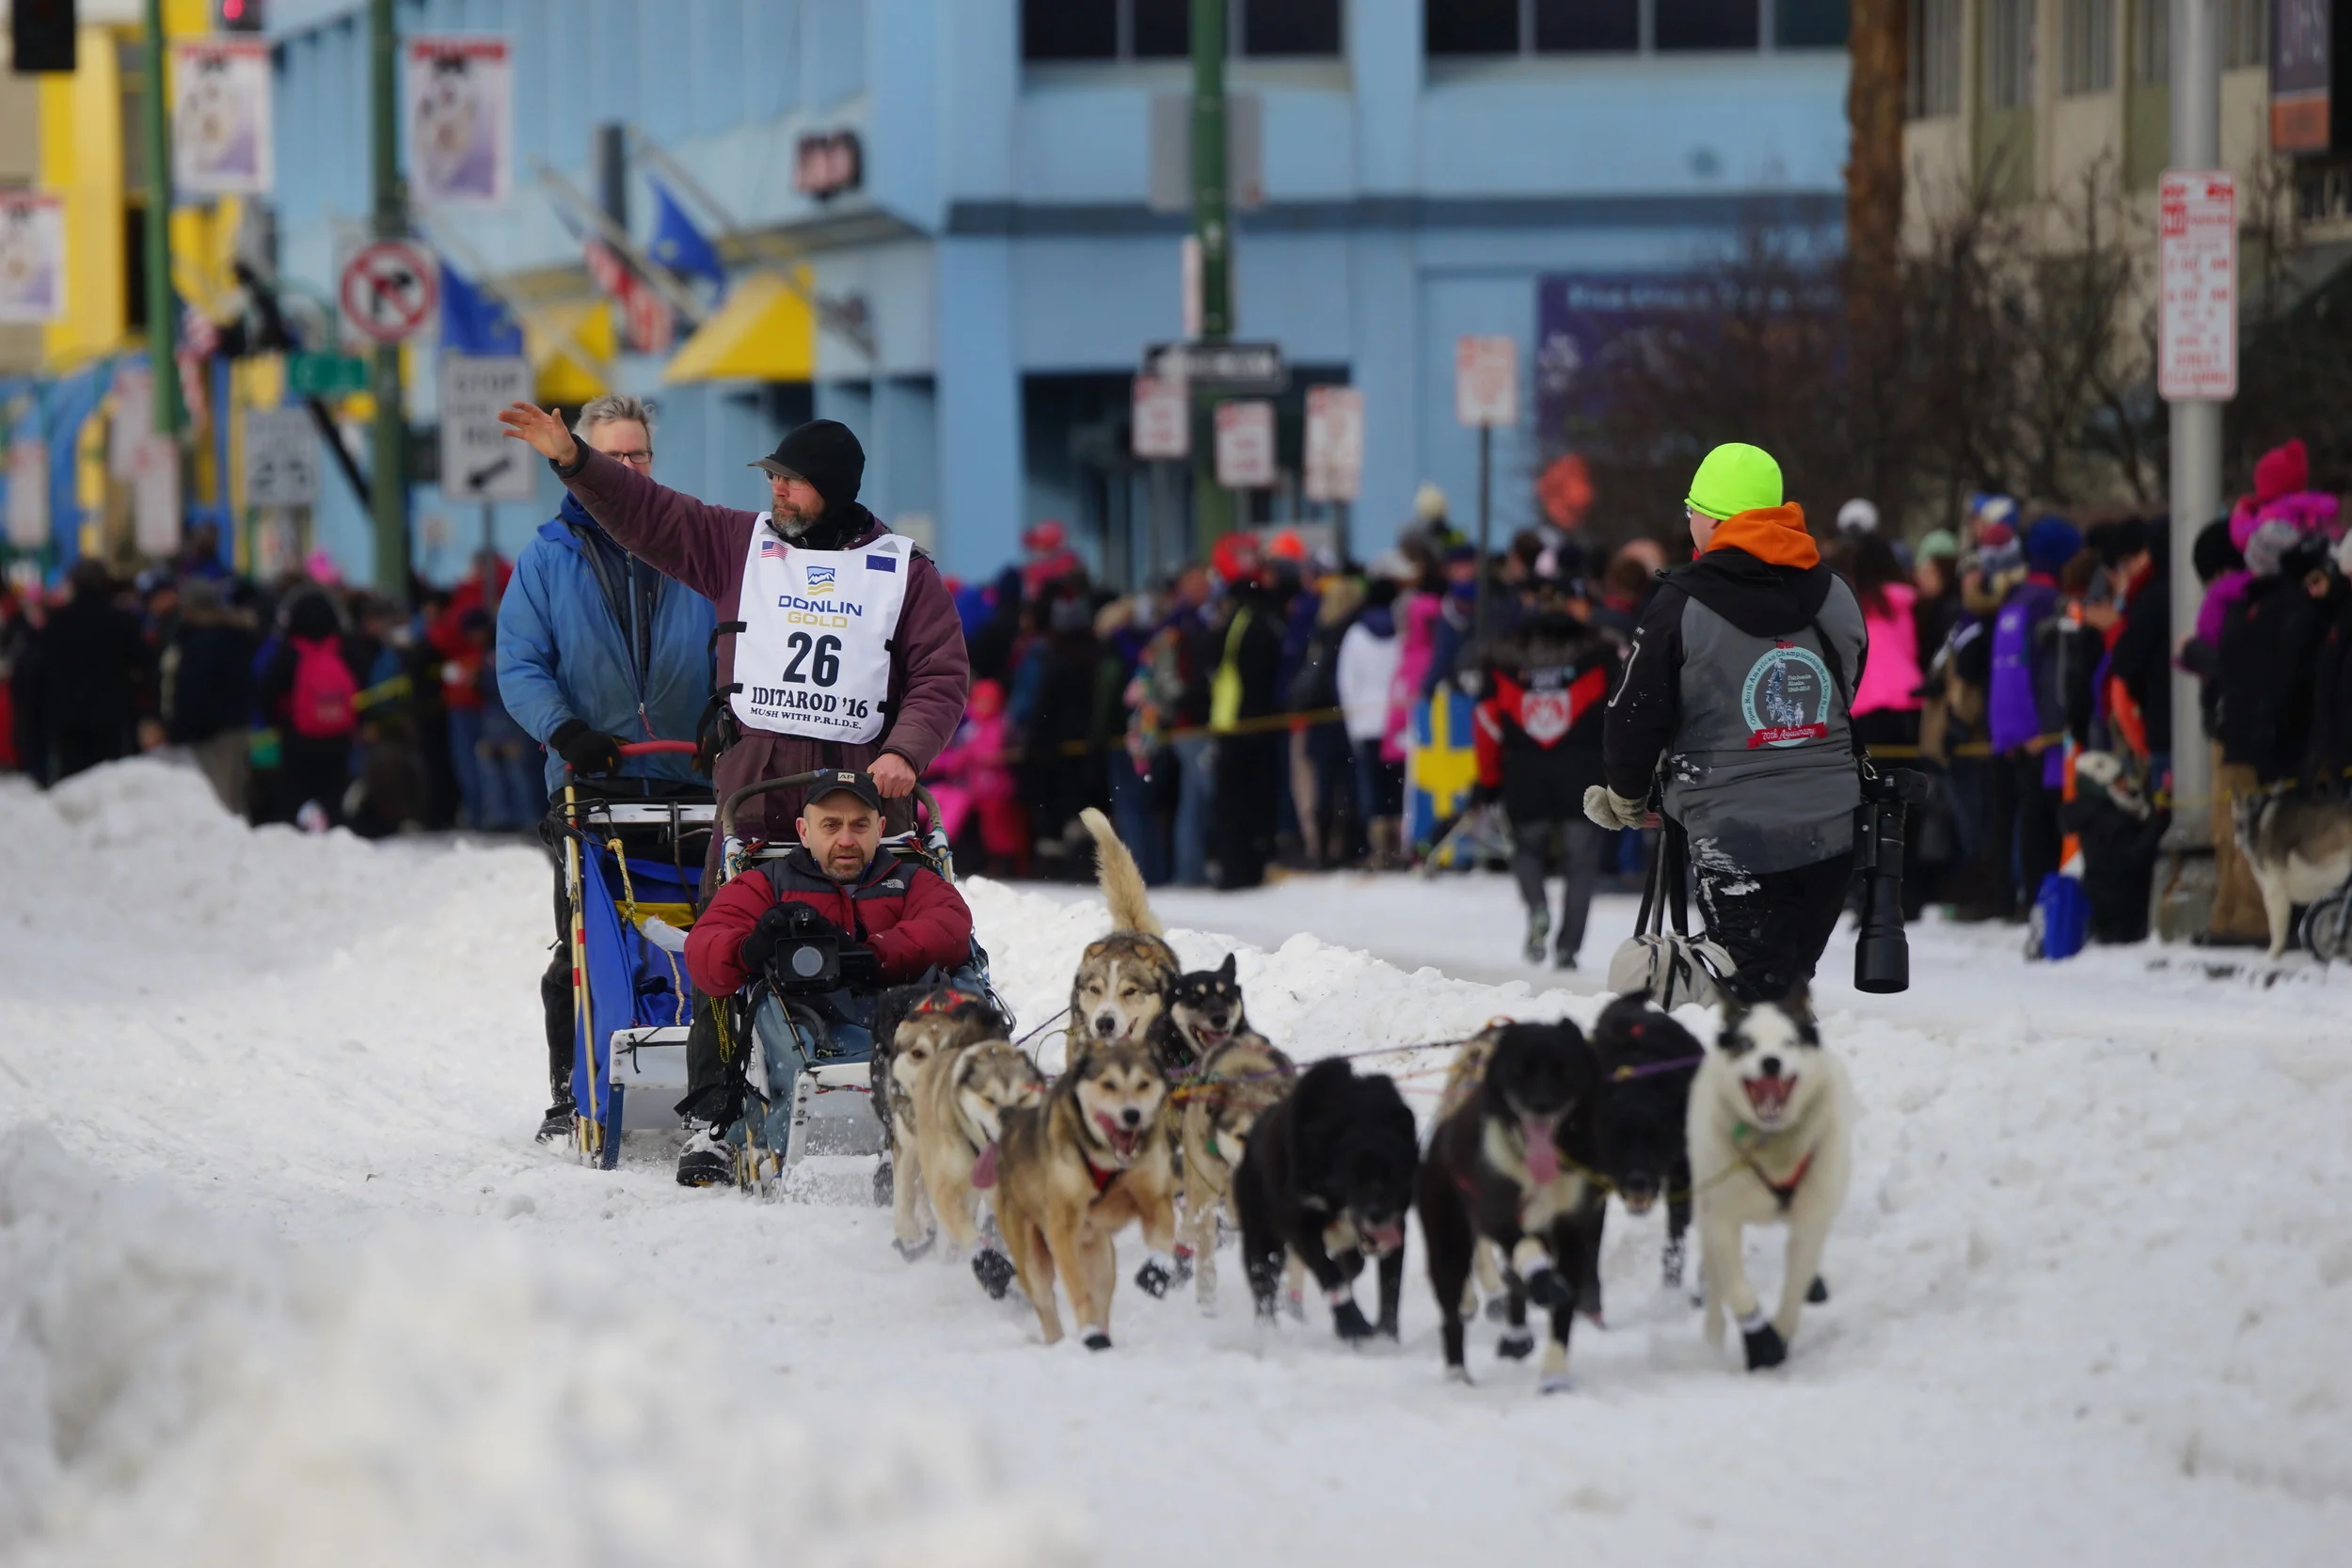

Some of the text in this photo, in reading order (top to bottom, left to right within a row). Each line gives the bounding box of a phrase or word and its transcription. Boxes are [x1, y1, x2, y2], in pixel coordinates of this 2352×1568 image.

[778, 594, 863, 617] DONLIN
[787, 611, 848, 628] GOLD
[782, 631, 842, 687] 26
[1744, 683, 1754, 705] North
[1751, 655, 1776, 683] American
[751, 687, 868, 719] IDITAROD '16
[750, 707, 863, 730] MUSH WITH P.R.I.D.E.
[1761, 726, 1816, 740] 70th Anniversary
